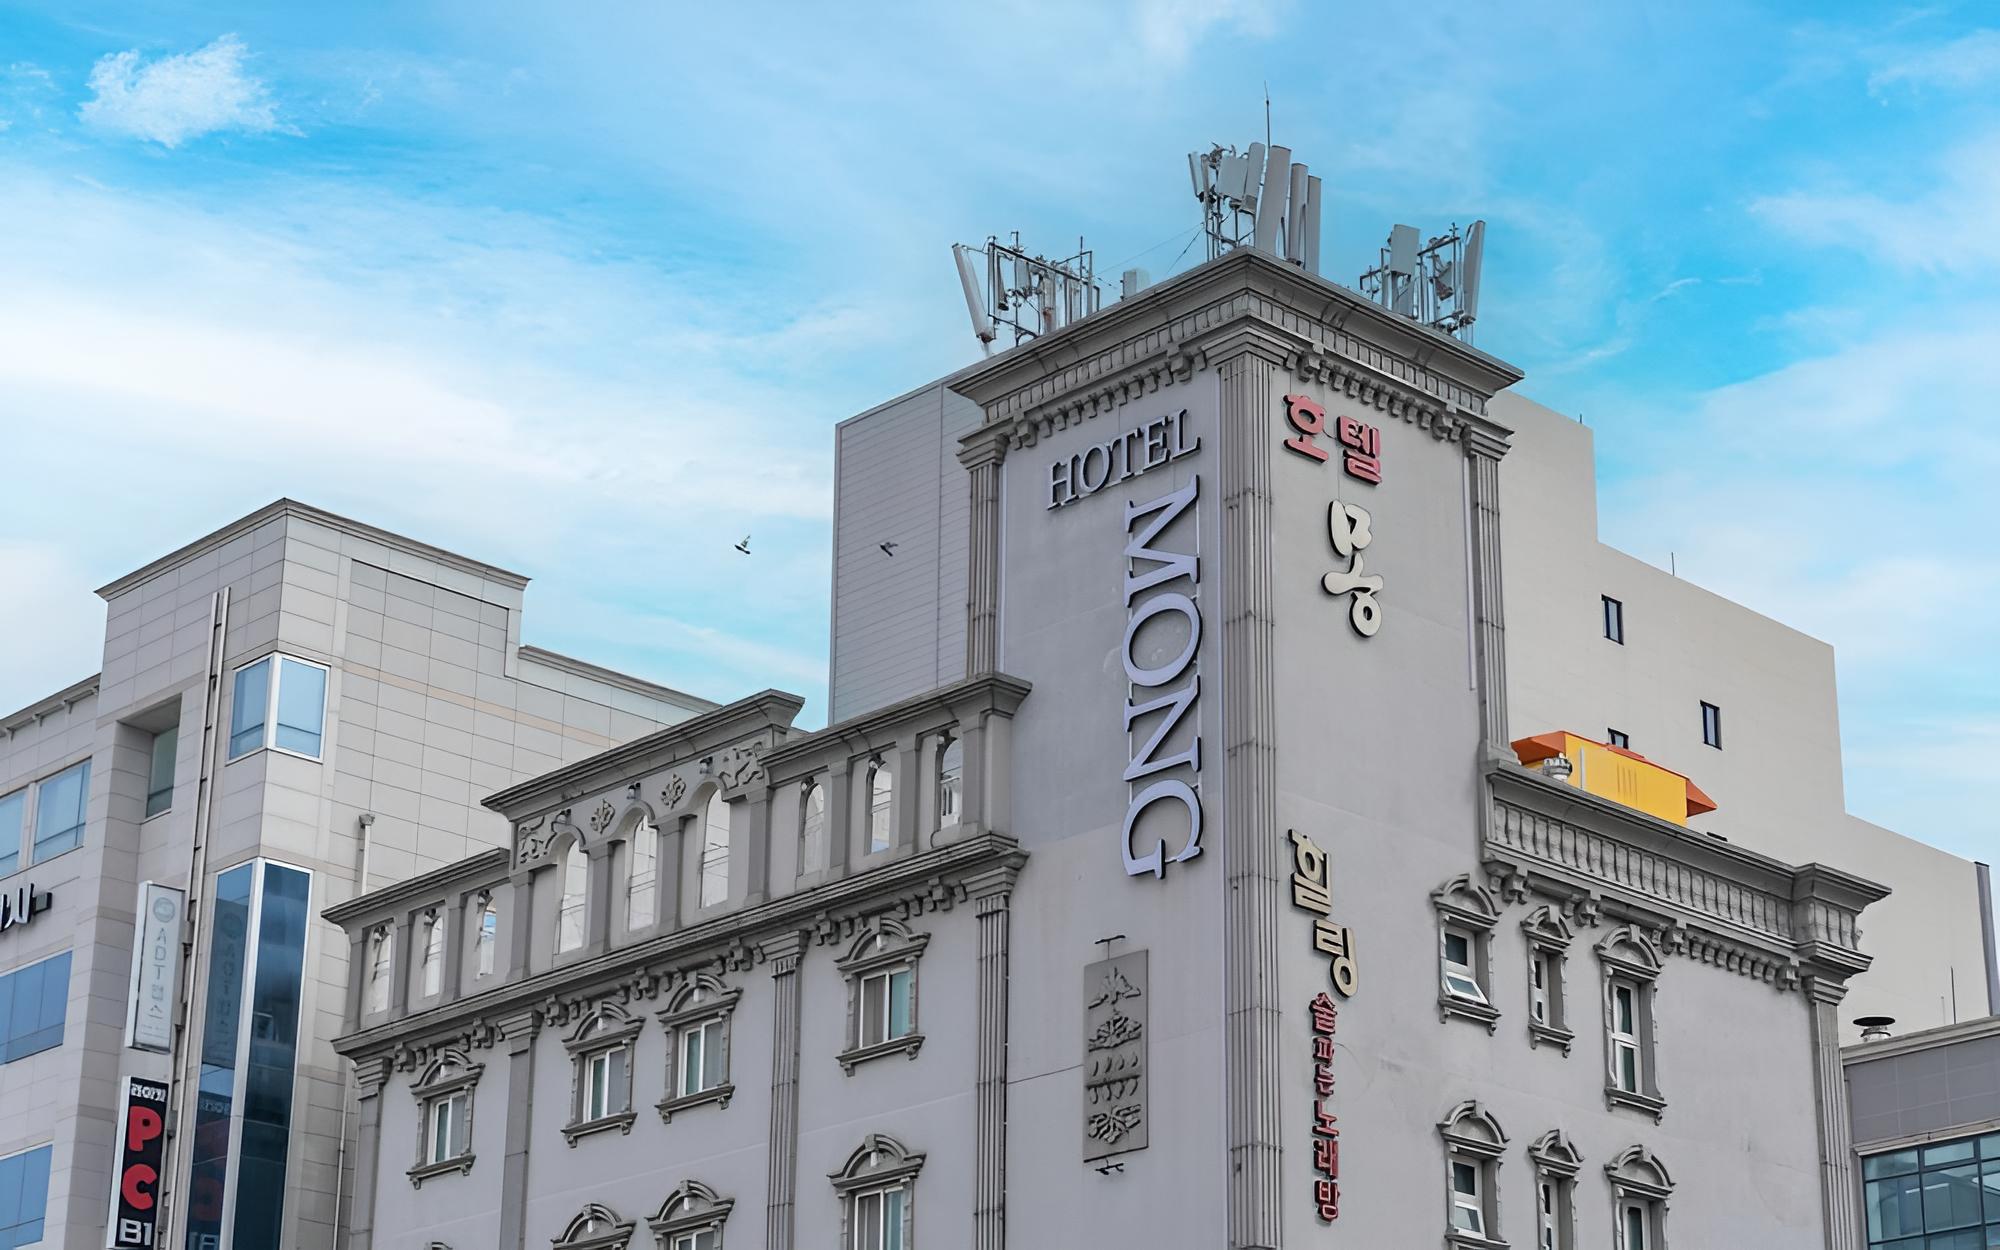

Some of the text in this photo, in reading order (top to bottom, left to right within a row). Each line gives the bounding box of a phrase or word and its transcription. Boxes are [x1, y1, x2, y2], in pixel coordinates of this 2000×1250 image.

[1047, 408, 1201, 511] HOTEL
[1283, 394, 1382, 486] 호텔
[1321, 500, 1384, 638] 몽
[1121, 474, 1203, 880] MONG
[1288, 829, 1359, 998] 힐링
[121, 1105, 163, 1211] PC
[119, 1217, 153, 1246] B1
